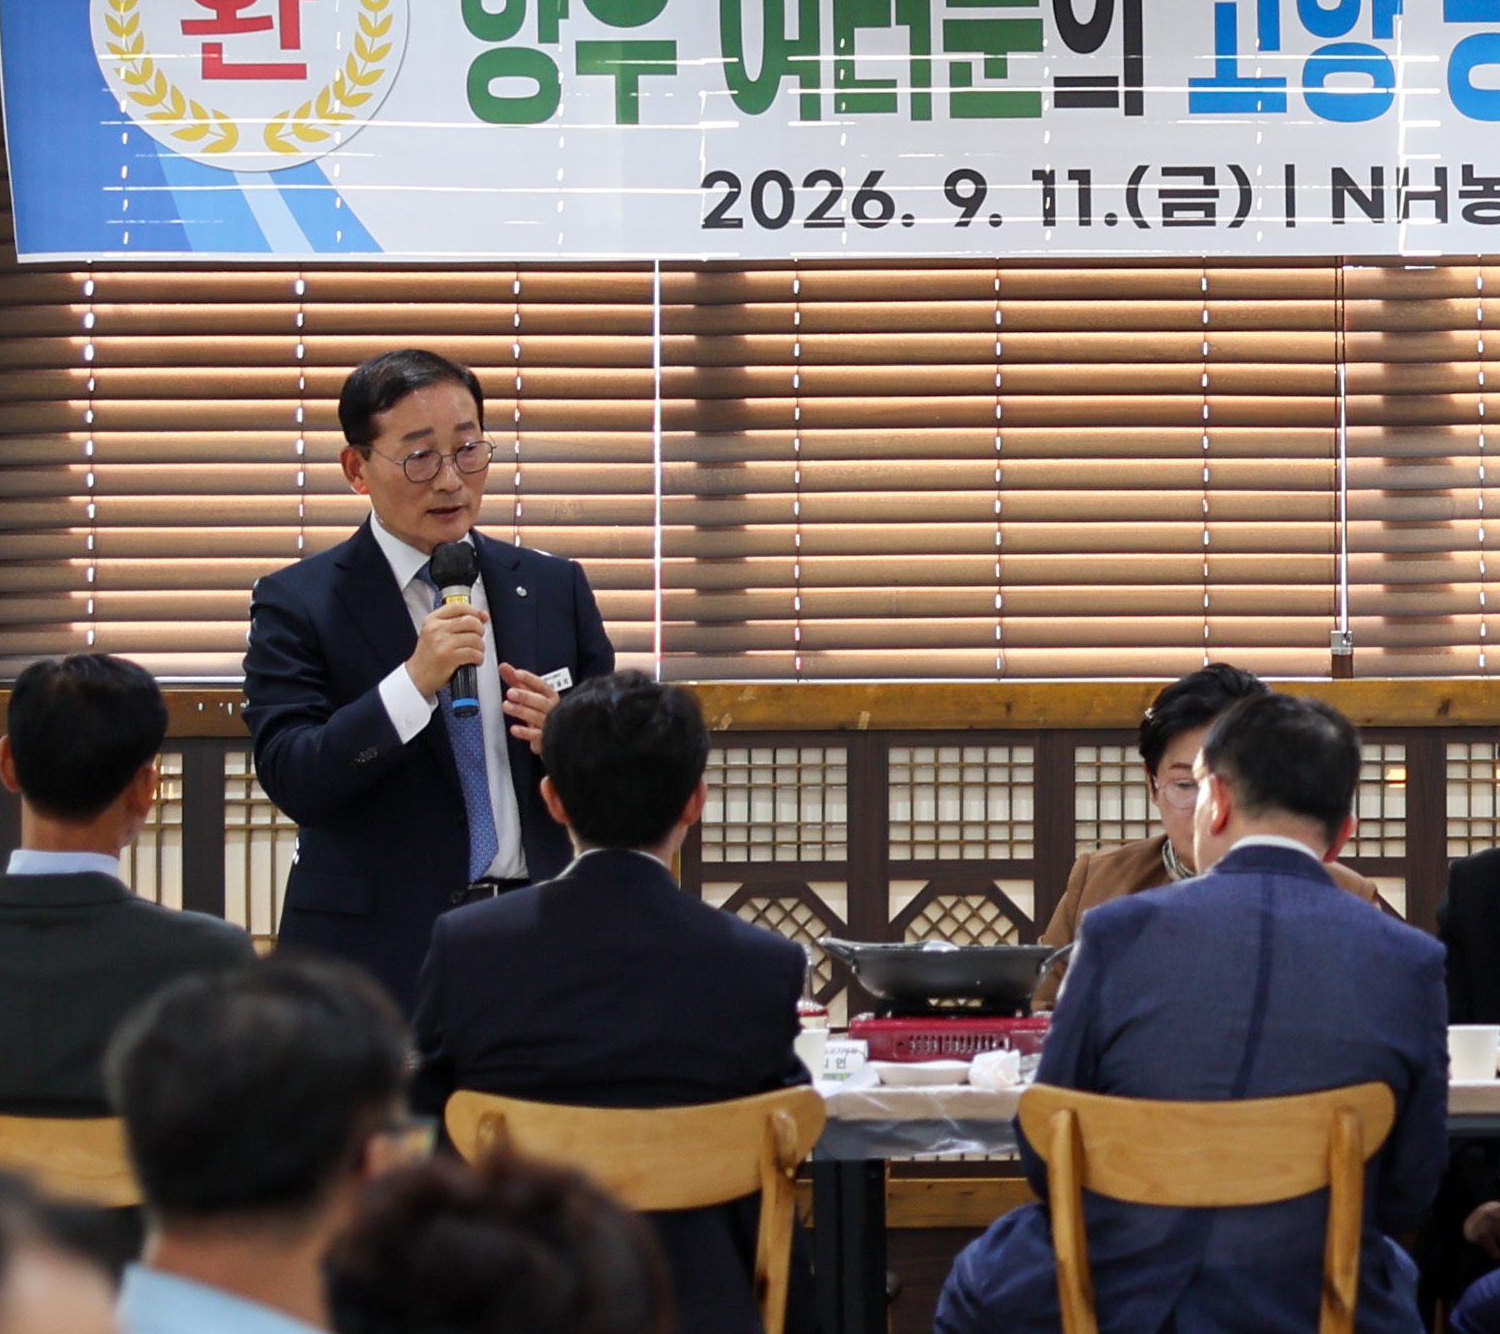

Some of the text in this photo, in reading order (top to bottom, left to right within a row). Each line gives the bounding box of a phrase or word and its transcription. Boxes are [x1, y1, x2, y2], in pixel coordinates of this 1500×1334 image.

[702, 170, 913, 229] 2026.
[945, 169, 1001, 227] 9.
[1033, 165, 1251, 228] 11.(금)
